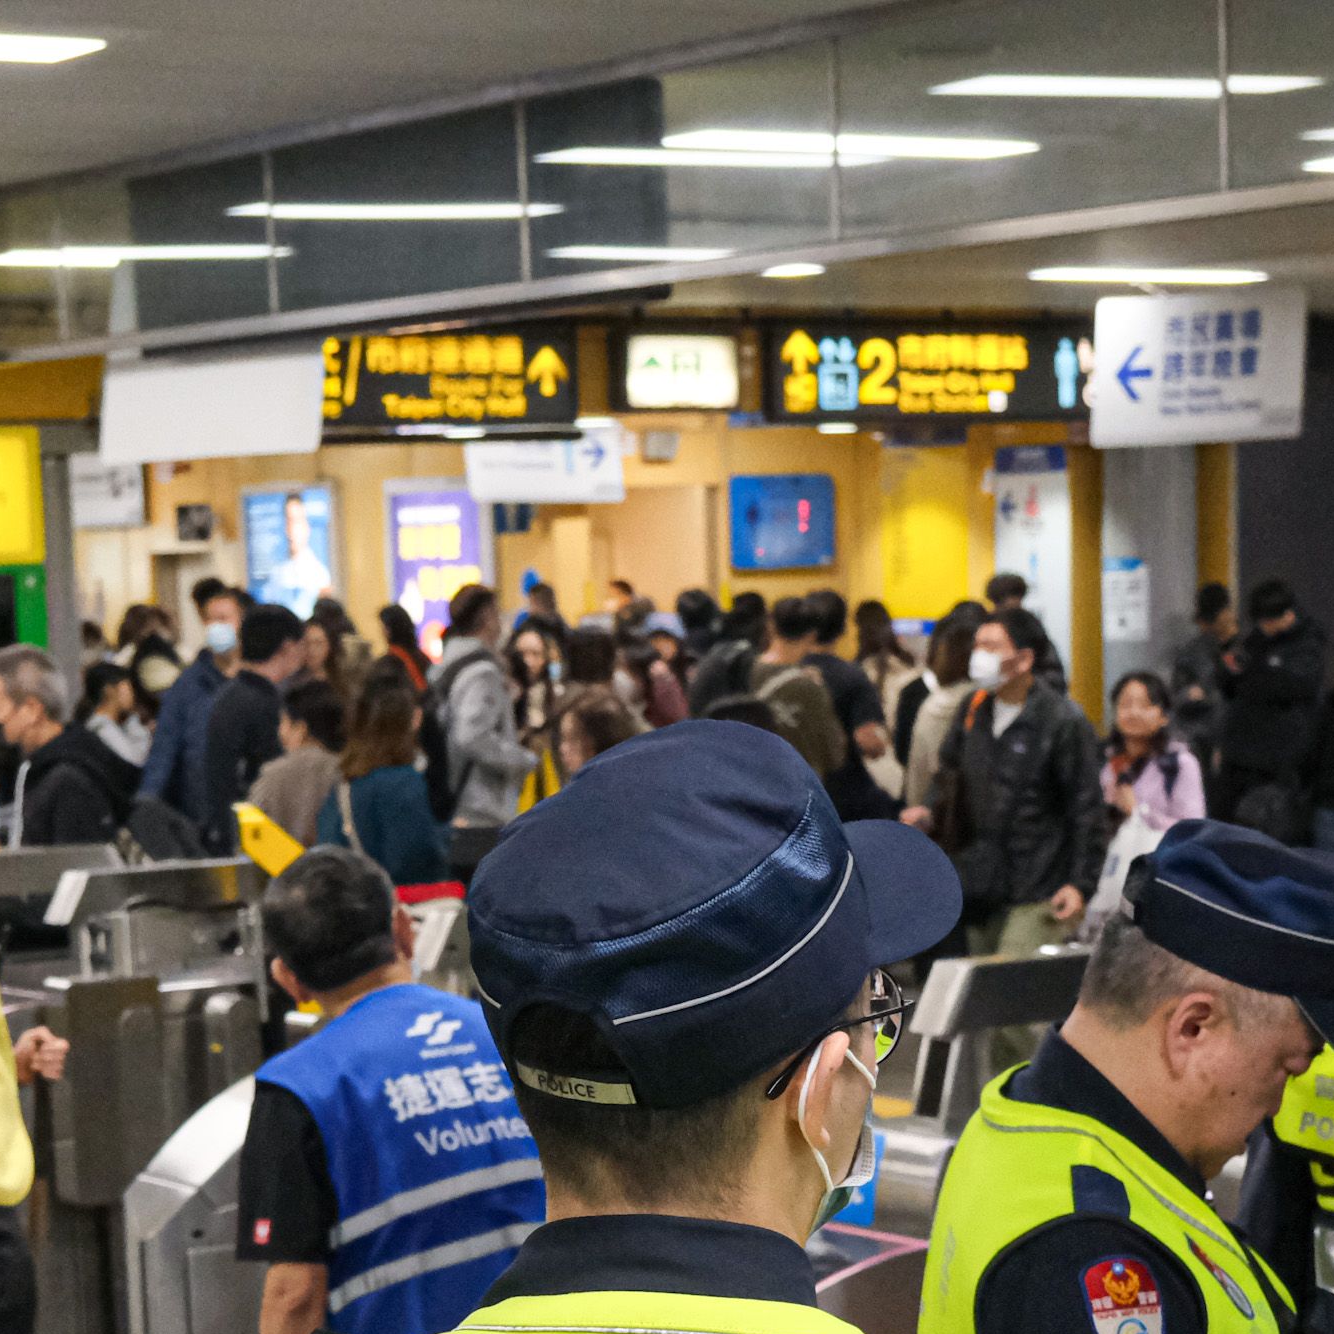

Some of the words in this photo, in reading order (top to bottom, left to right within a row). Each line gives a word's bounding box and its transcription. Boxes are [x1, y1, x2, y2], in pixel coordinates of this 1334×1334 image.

[858, 338, 897, 404] 2
[384, 1061, 515, 1123] 捷運志
[538, 1074, 596, 1099] POLICE
